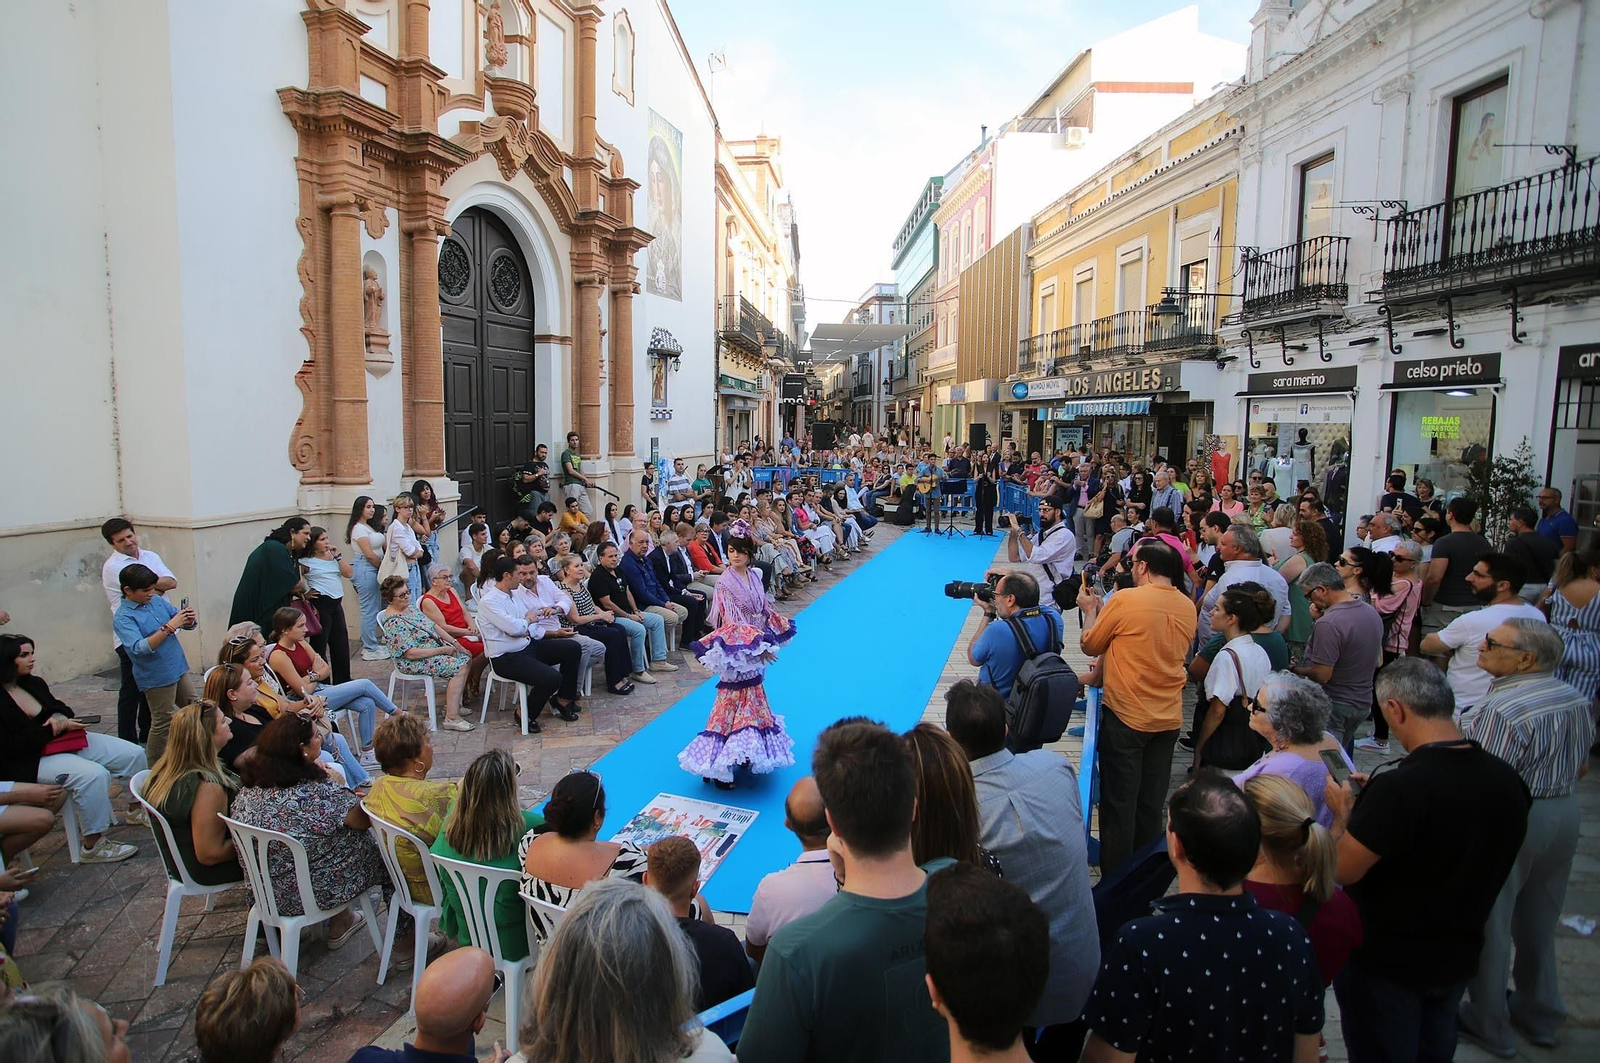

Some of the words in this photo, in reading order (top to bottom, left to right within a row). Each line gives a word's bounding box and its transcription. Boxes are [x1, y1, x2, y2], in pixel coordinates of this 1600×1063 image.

[1407, 361, 1439, 378] celso
[1439, 357, 1482, 381] prieto
[1067, 376, 1089, 395] LOS
[1094, 367, 1161, 394] ANGELES
[1273, 378, 1293, 387] sara
[1293, 373, 1326, 387] merino
[1082, 404, 1094, 413] LOS
[1094, 403, 1127, 413] ANGELES
[1421, 416, 1460, 425] REBAJAS
